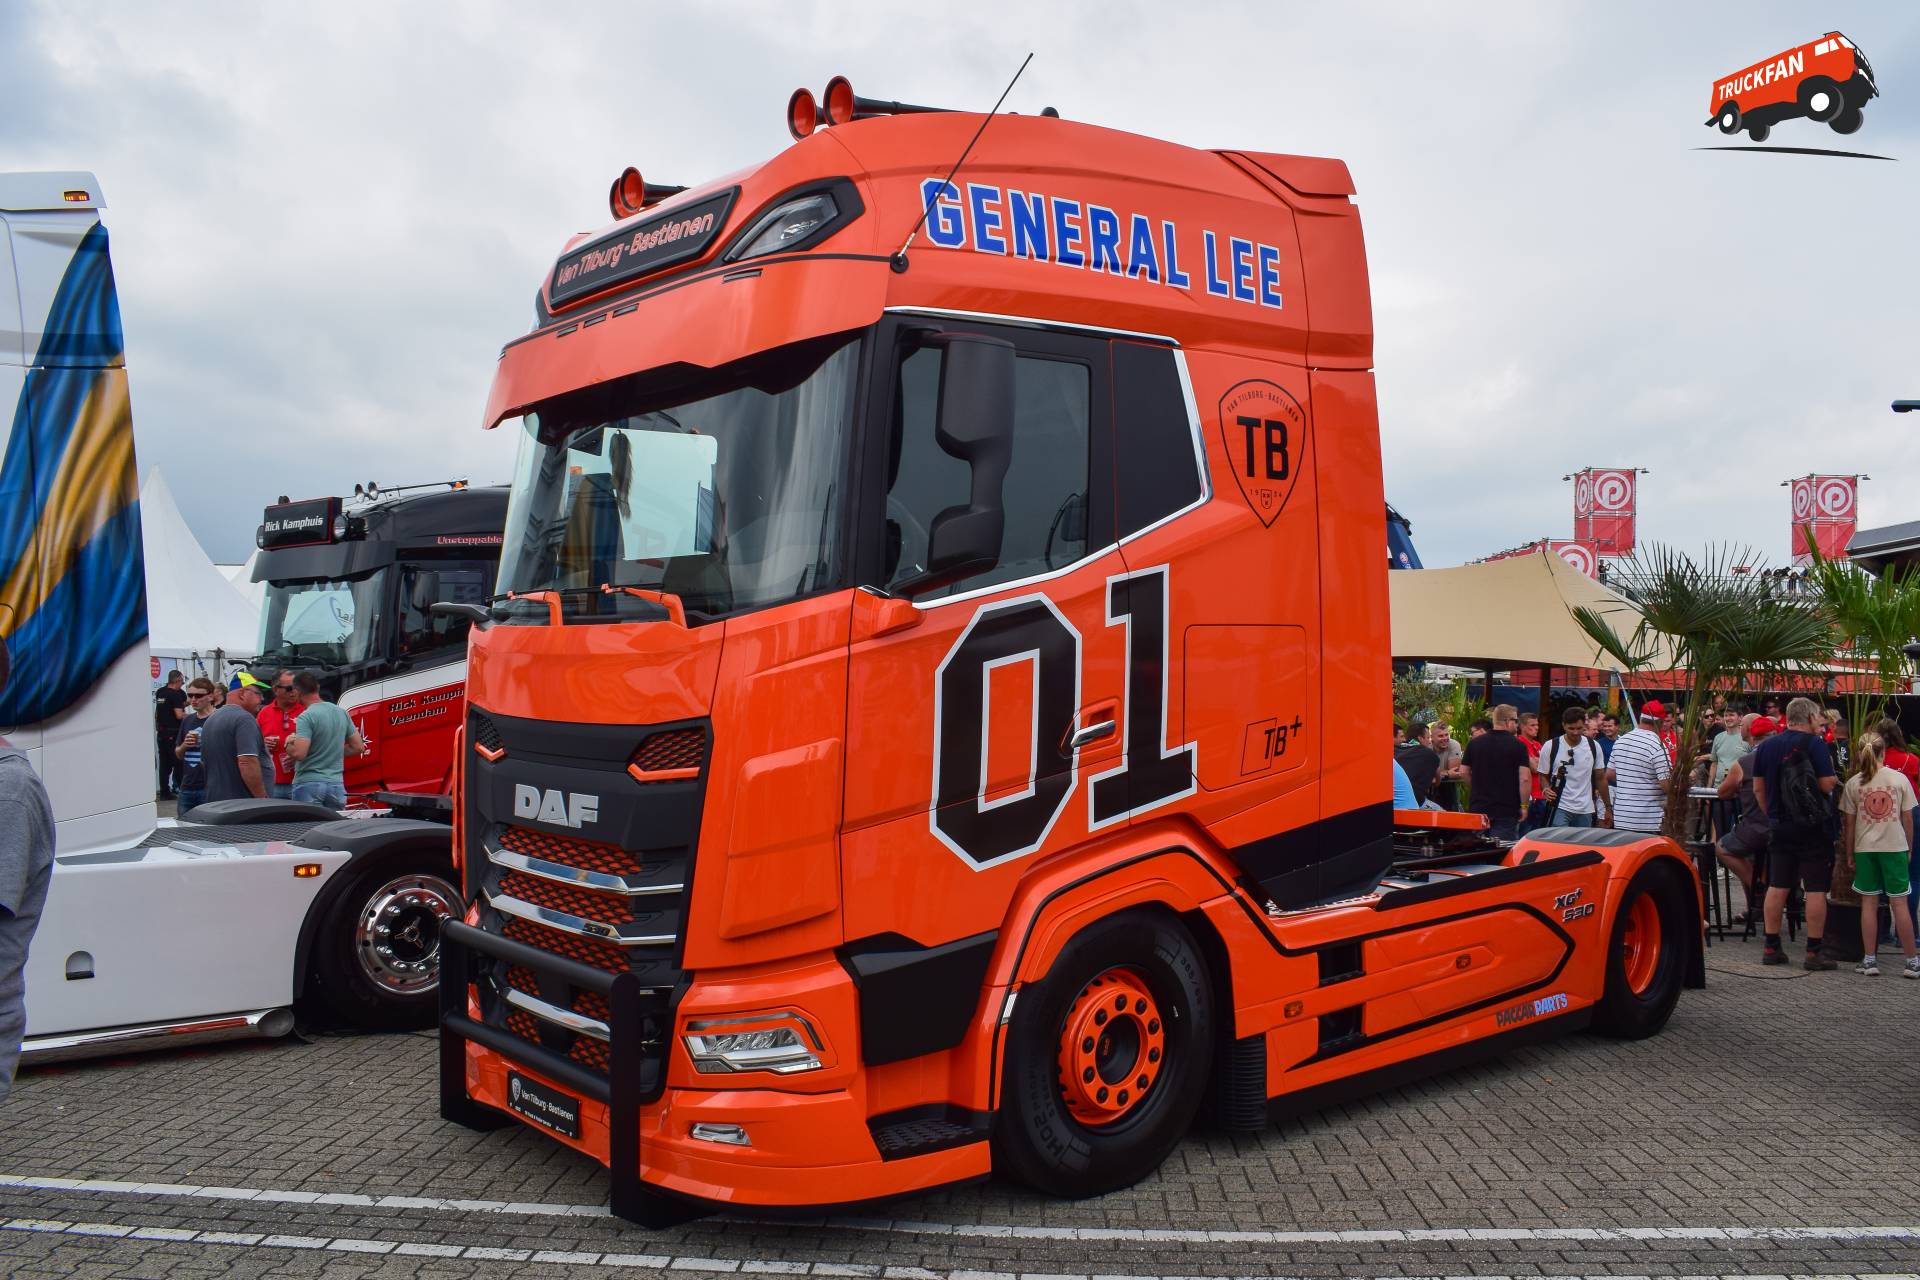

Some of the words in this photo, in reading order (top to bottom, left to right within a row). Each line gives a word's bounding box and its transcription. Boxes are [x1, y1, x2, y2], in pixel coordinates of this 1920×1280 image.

[919, 177, 1191, 290] GENERAL
[1202, 229, 1283, 309] LEE
[557, 263, 580, 287] Van
[1236, 415, 1290, 481] TB
[264, 521, 281, 532] Rick
[282, 515, 325, 531] Kamphuis
[929, 563, 1198, 873] 01
[514, 783, 599, 829] DAF
